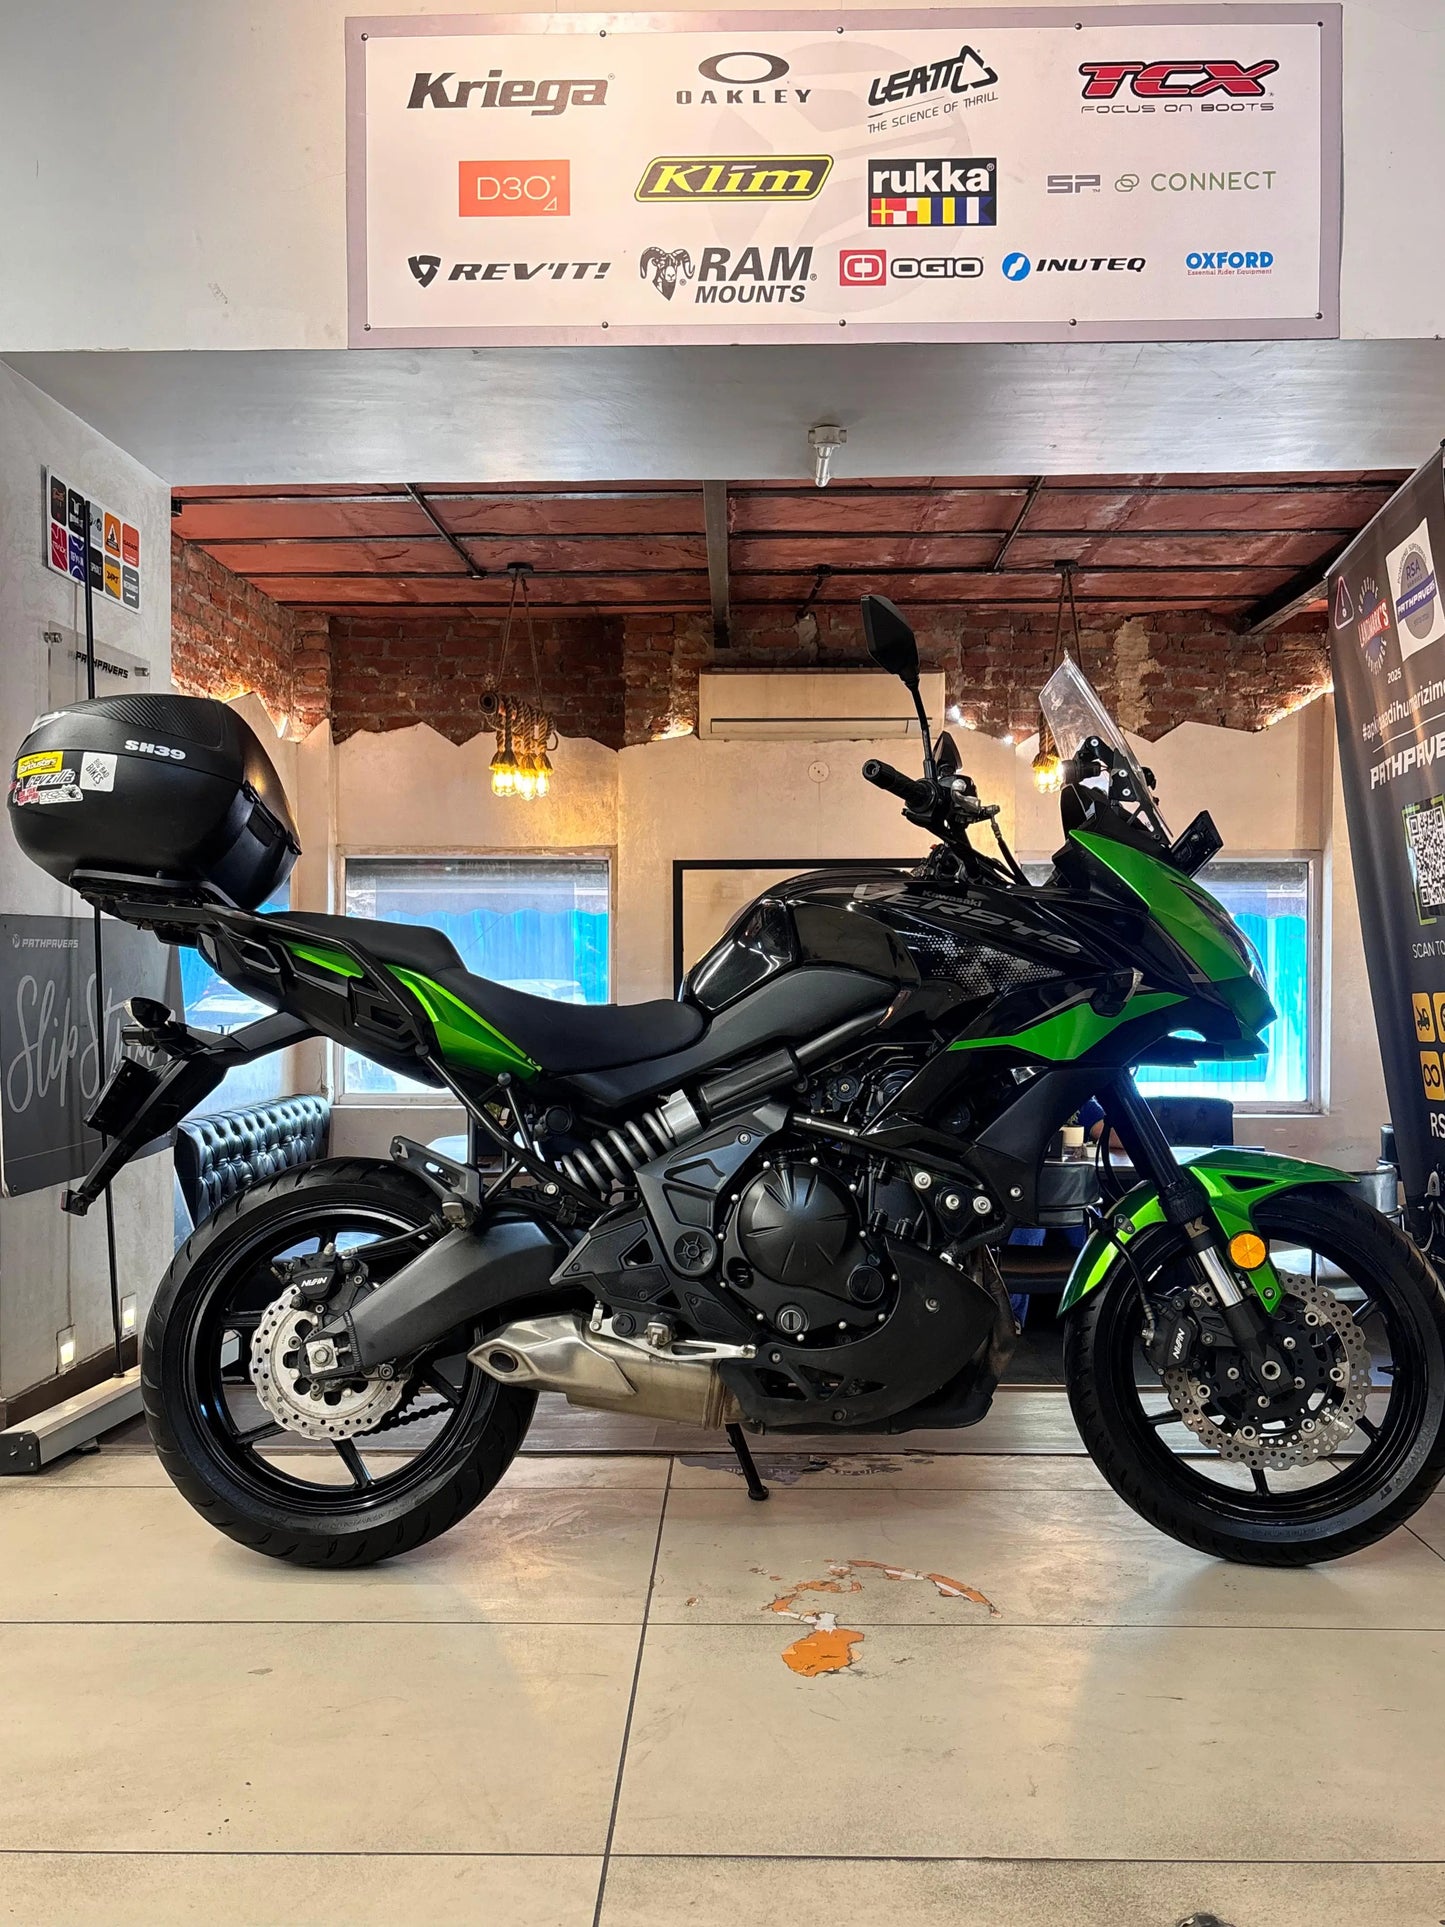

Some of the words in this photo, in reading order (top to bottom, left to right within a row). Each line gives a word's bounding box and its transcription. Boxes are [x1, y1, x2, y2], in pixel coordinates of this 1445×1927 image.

[1079, 60, 1279, 99] TCX
[406, 70, 608, 116] Kriega
[676, 88, 811, 105] OAKLEY
[868, 120, 888, 134] THE
[892, 106, 939, 128] SCIENCE
[944, 101, 958, 113] OF
[963, 91, 998, 108] THRILL
[1081, 104, 1156, 113] FOCUS
[1201, 102, 1275, 112] BOOTS
[872, 162, 990, 193] rukka
[1150, 170, 1276, 192] CONNECT
[698, 246, 813, 282] RAM
[890, 256, 983, 279] OGIO
[1036, 257, 1146, 273] INUTEQ
[1185, 252, 1274, 269] OXFORD
[694, 284, 806, 304] MOUNTS
[1406, 558, 1420, 581] RSA
[76, 651, 129, 679] PAHPAVERS
[1388, 667, 1402, 684] 2025
[125, 740, 186, 760] SH39
[85, 763, 104, 785] BIKES
[922, 889, 982, 908] Kawasaki
[853, 883, 1084, 954] VERSYS
[22, 938, 79, 949] PATHPAVERS
[1412, 942, 1435, 959] SCAN
[7, 975, 78, 1113] Slip
